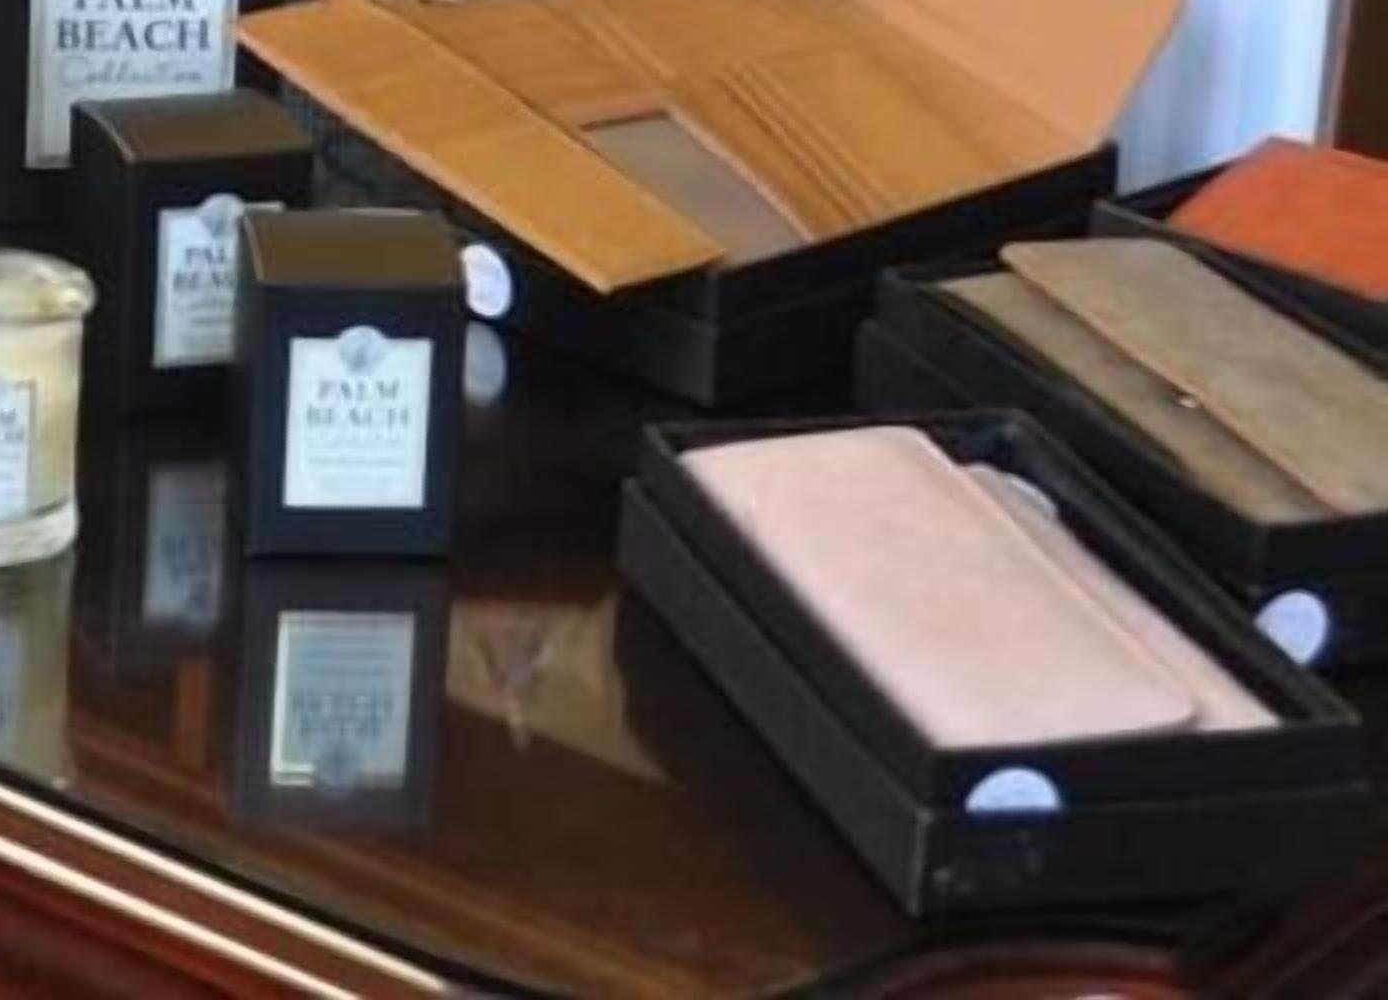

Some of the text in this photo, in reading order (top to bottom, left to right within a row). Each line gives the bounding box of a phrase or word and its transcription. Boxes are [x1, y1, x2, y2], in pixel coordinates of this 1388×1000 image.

[55, 17, 212, 53] BEACH
[183, 247, 235, 267] PAL
[317, 378, 401, 401] PALM
[306, 406, 410, 426] BEACH
